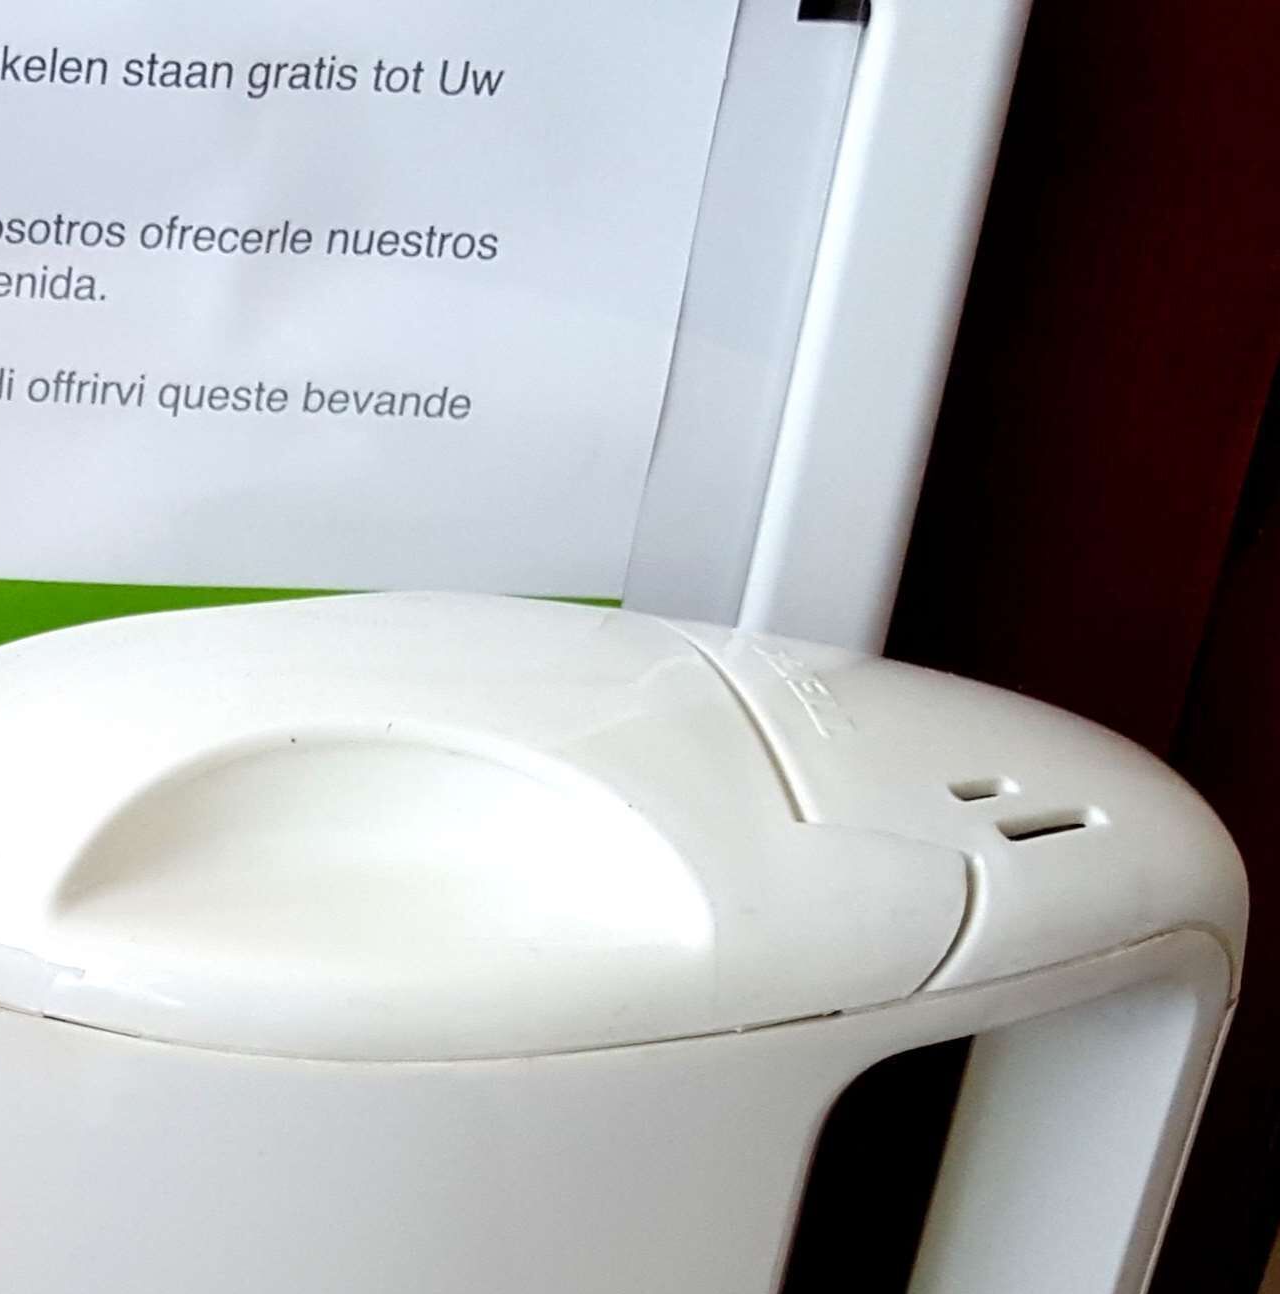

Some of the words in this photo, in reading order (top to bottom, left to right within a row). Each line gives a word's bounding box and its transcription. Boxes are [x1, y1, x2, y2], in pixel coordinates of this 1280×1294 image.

[121, 52, 234, 90] staan
[246, 54, 359, 100] gratis
[372, 58, 426, 95] tot
[438, 59, 506, 97] Uw
[139, 214, 313, 255] ofrecerle
[326, 224, 499, 261] nuestros
[27, 369, 146, 408] offrirvi
[157, 380, 289, 418] queste
[302, 381, 472, 420] bevande
